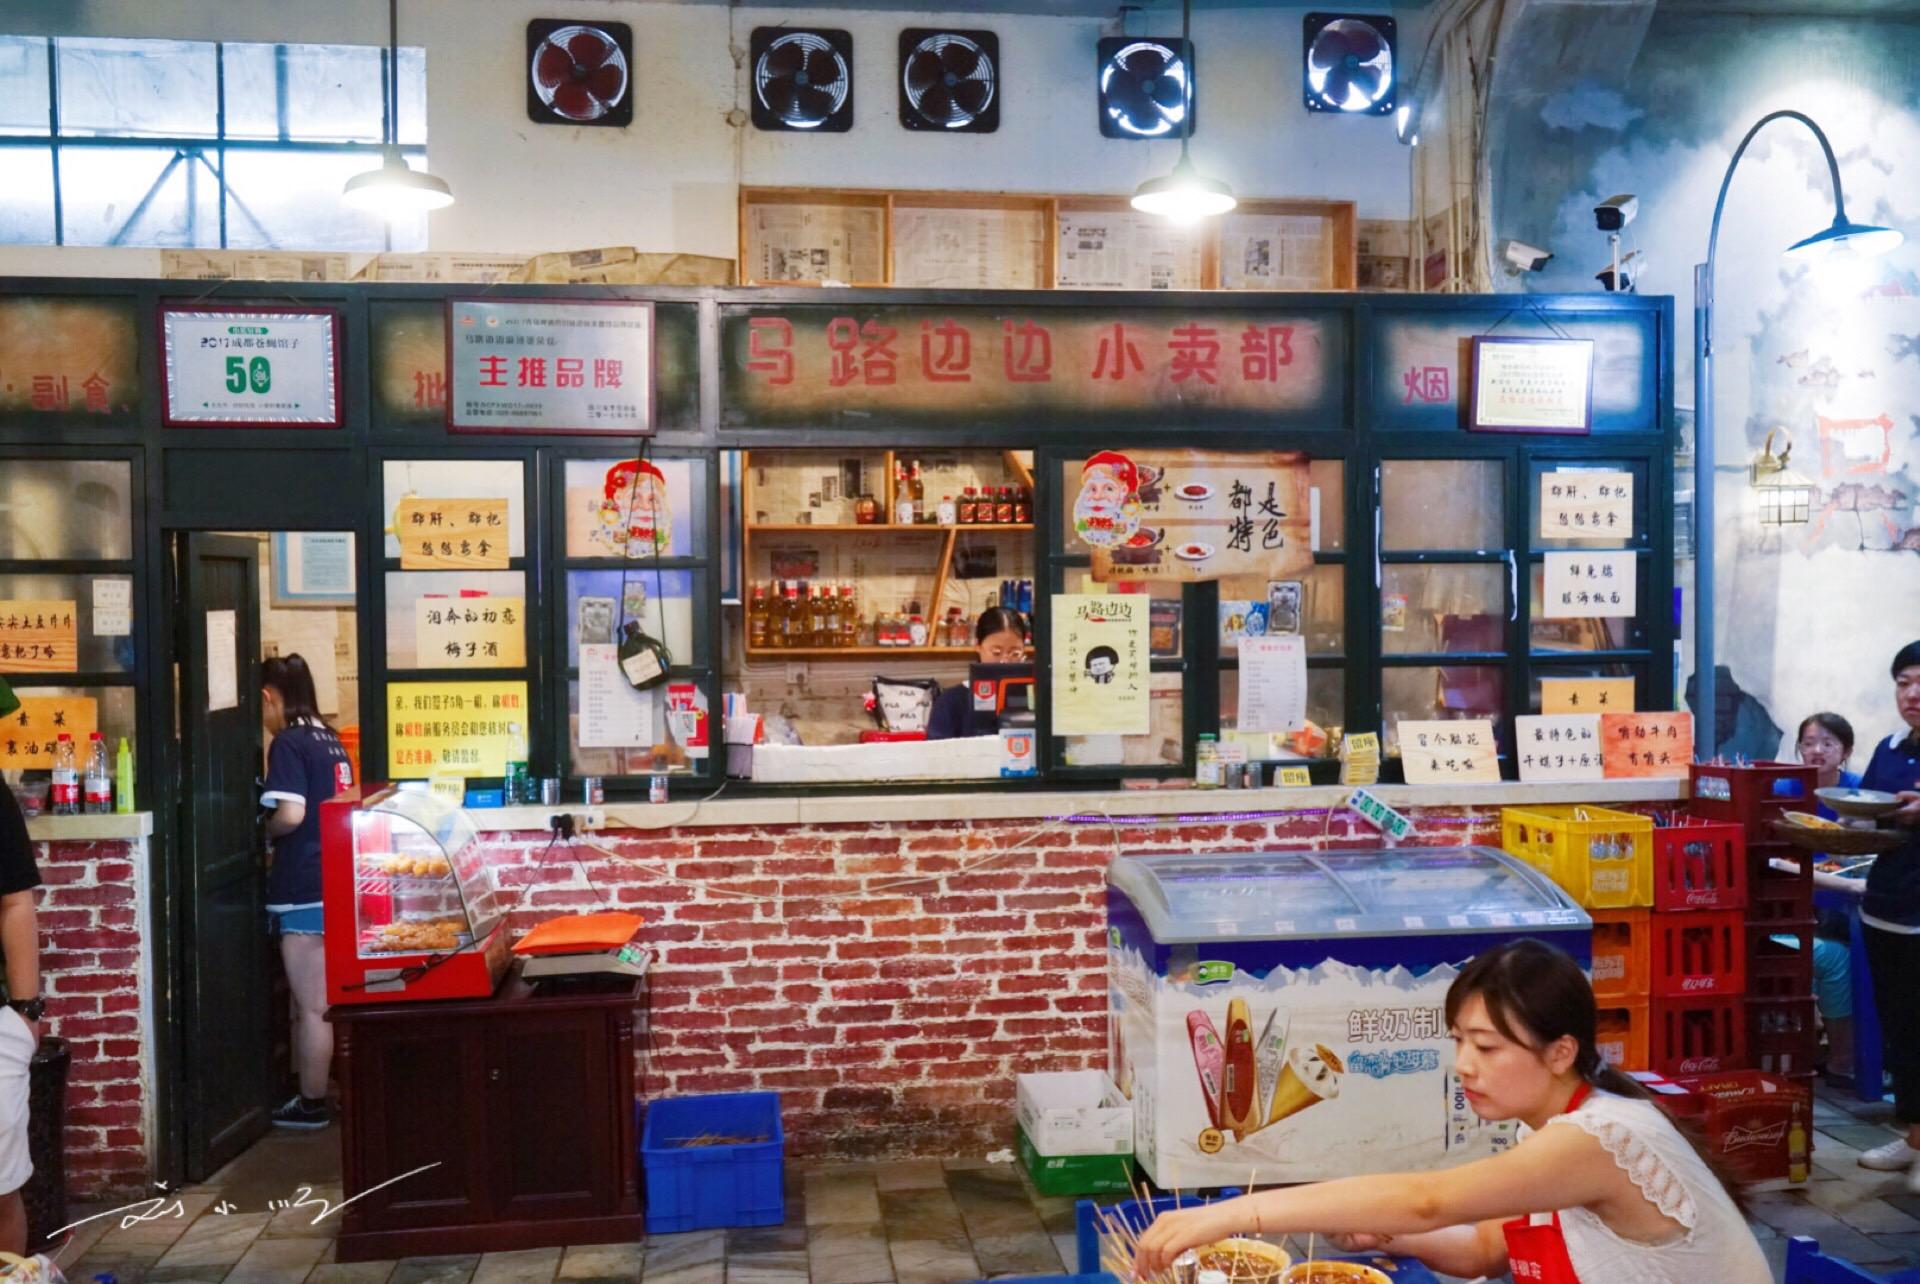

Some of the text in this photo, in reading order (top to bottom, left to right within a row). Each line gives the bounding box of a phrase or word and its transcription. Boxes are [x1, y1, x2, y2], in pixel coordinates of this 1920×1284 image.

[745, 316, 1295, 386] 马路边边小卖部
[225, 356, 271, 394] 50
[479, 355, 623, 389] 主推品牌
[1404, 365, 1449, 405] 烟
[445, 641, 498, 657] 梅子酒
[1534, 728, 1592, 742] 最特色的
